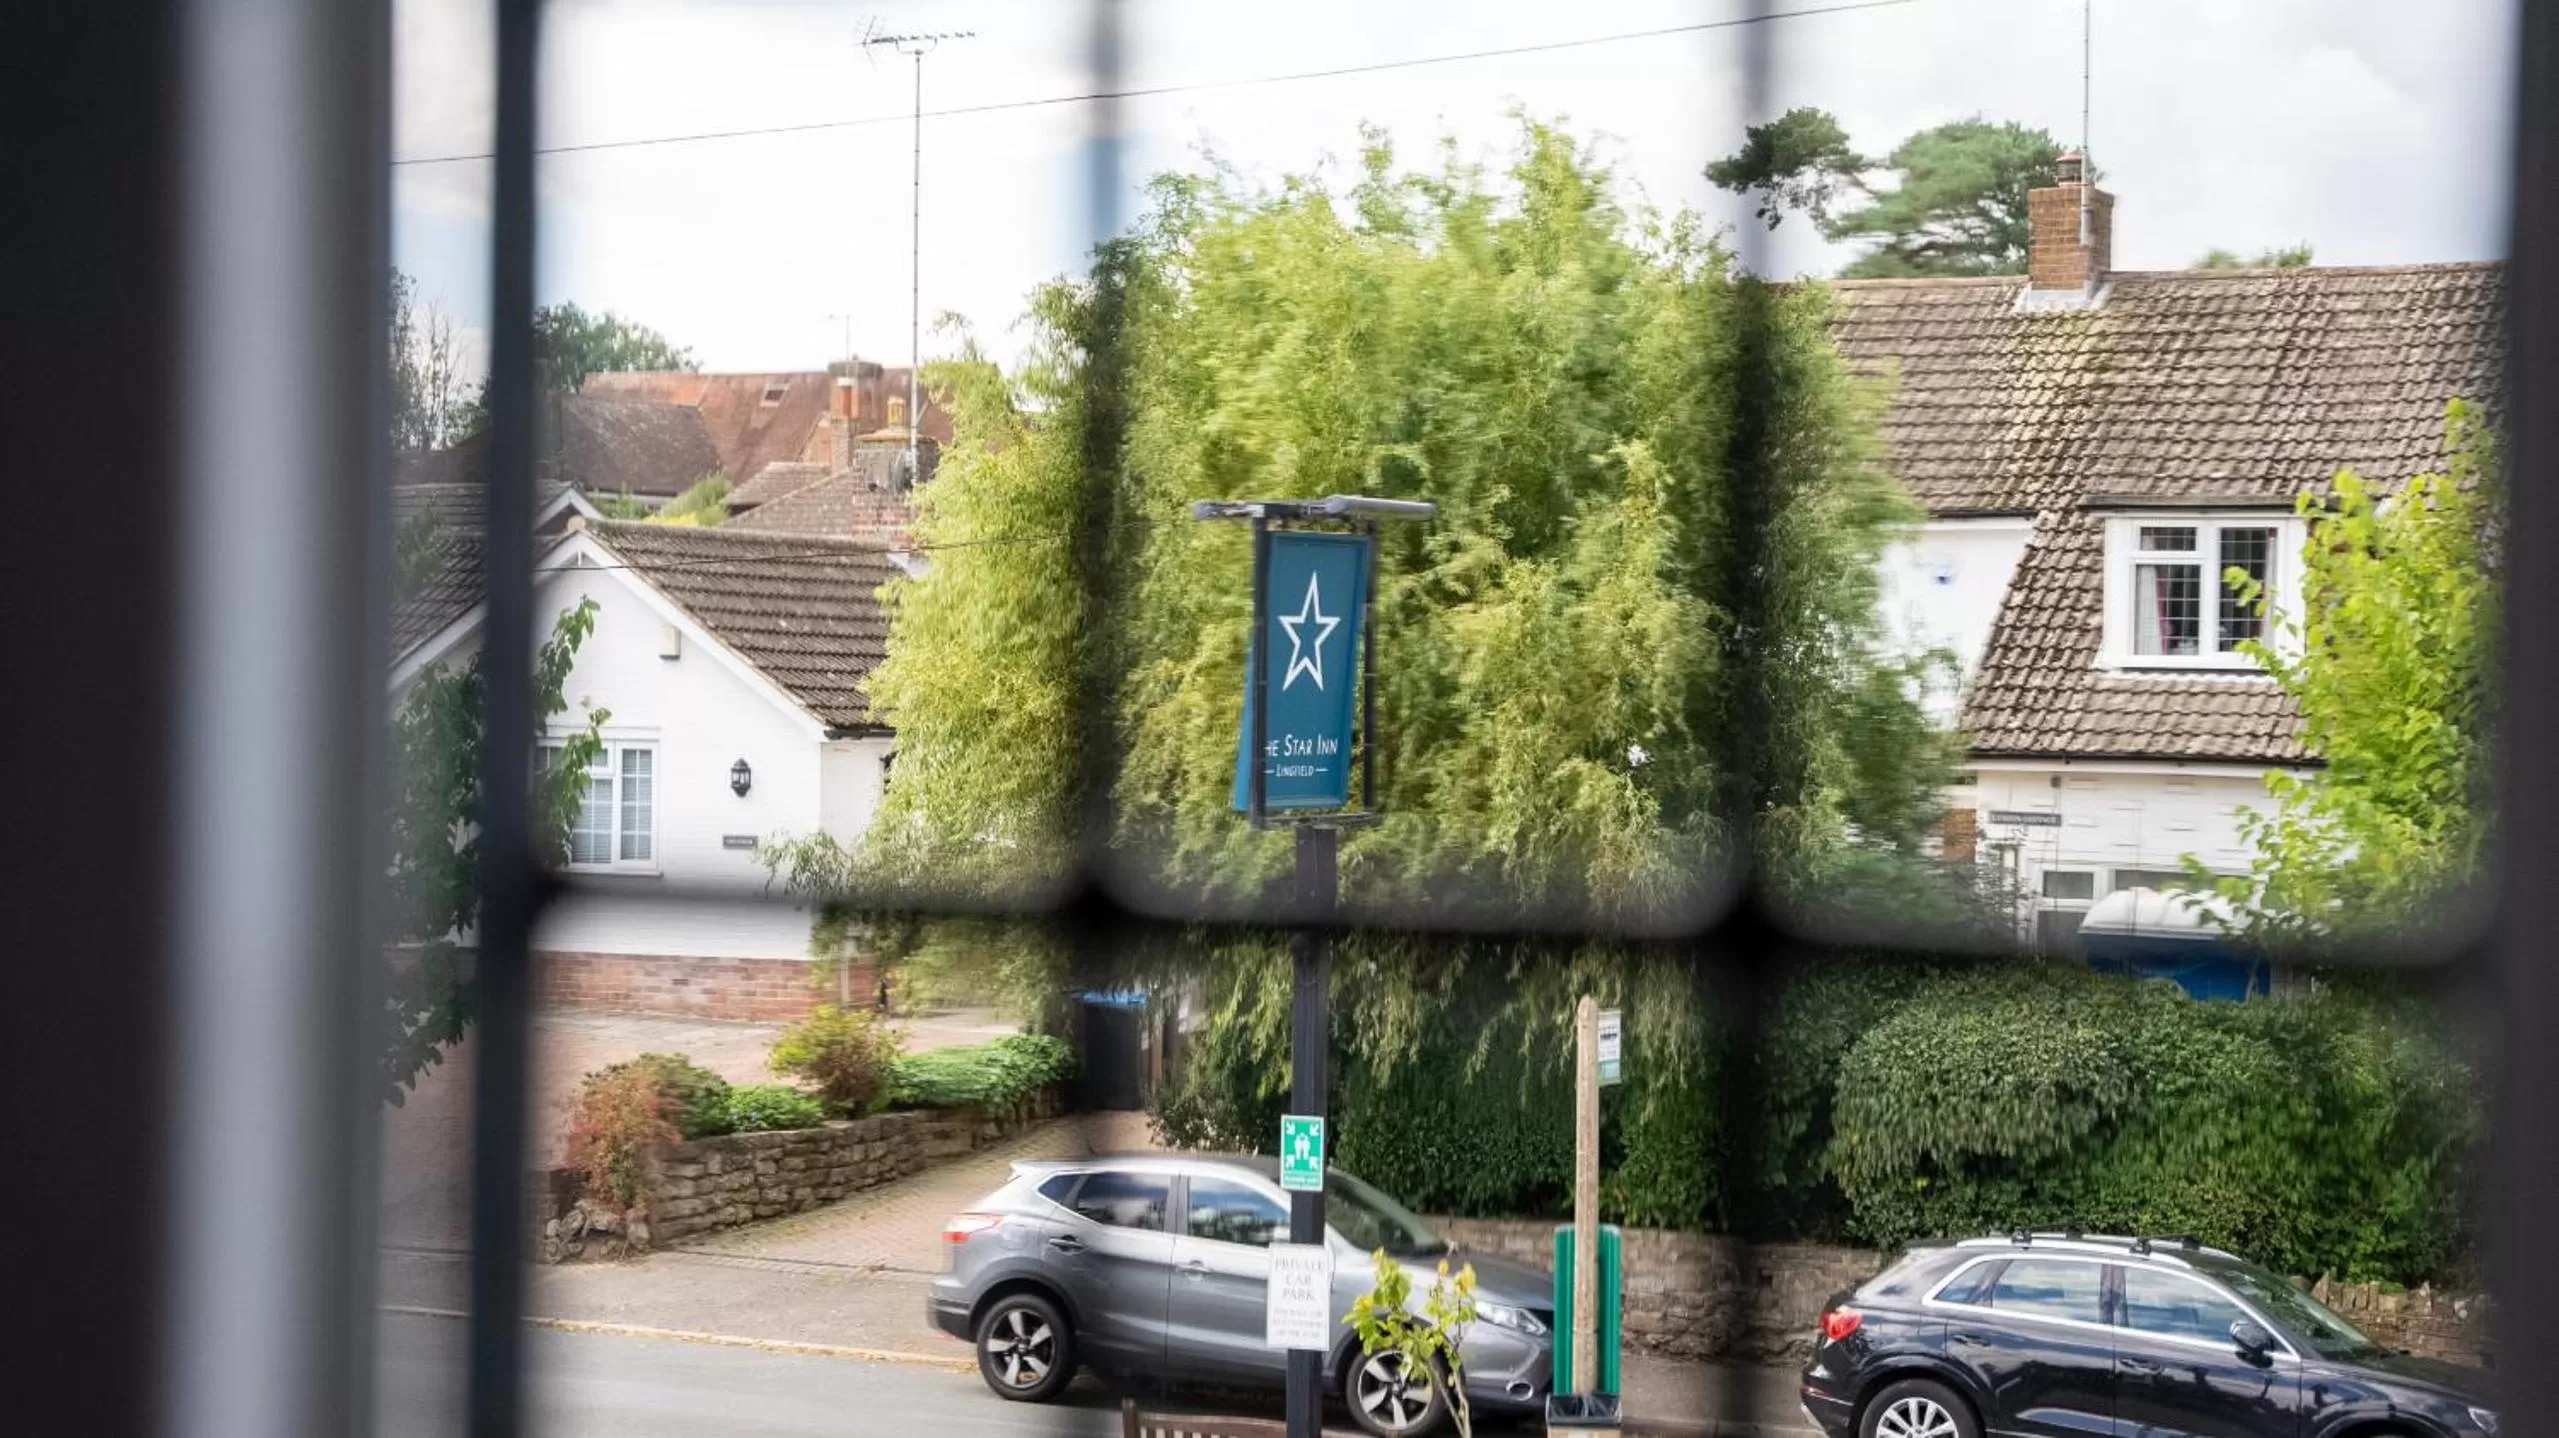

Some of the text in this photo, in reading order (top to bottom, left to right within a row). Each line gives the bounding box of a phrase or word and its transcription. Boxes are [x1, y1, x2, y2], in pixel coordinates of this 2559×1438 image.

[1265, 733, 1338, 757] HE STAR INN
[1275, 1256, 1324, 1271] PRIVATE
[1285, 1274, 1312, 1286] CAR
[1283, 1287, 1315, 1300] PARK
